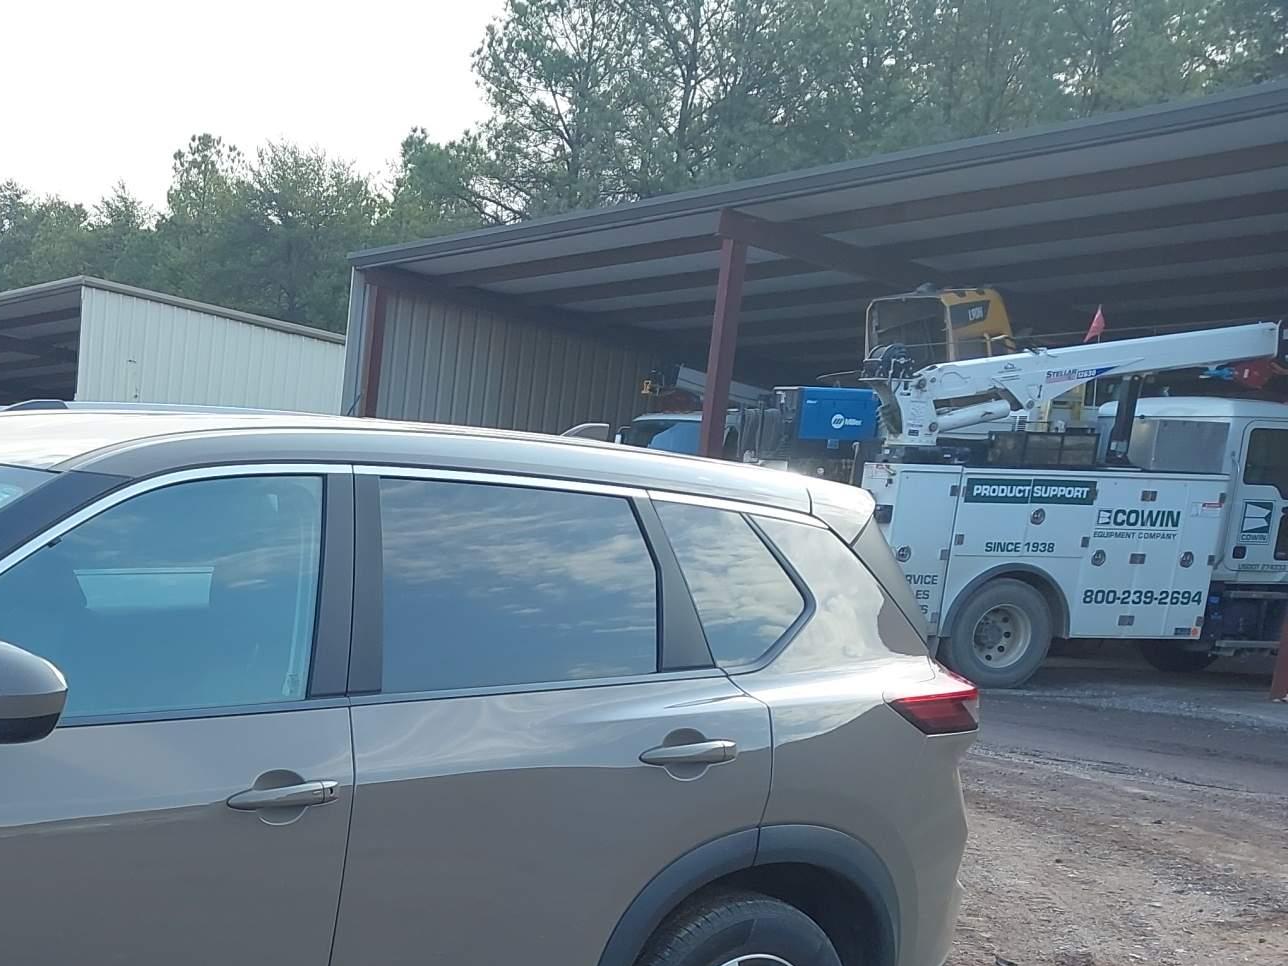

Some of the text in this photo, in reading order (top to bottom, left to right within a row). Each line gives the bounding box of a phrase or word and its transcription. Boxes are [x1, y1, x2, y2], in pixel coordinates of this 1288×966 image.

[973, 484, 1090, 499] PRODUCT SUPPORT
[1113, 508, 1181, 528] COWIN
[1093, 531, 1177, 540] EQUIPMENT COMPANY
[984, 541, 1055, 553] SINCE 1938
[905, 574, 939, 585] RVICE
[1082, 589, 1203, 605] 800-239-2694
